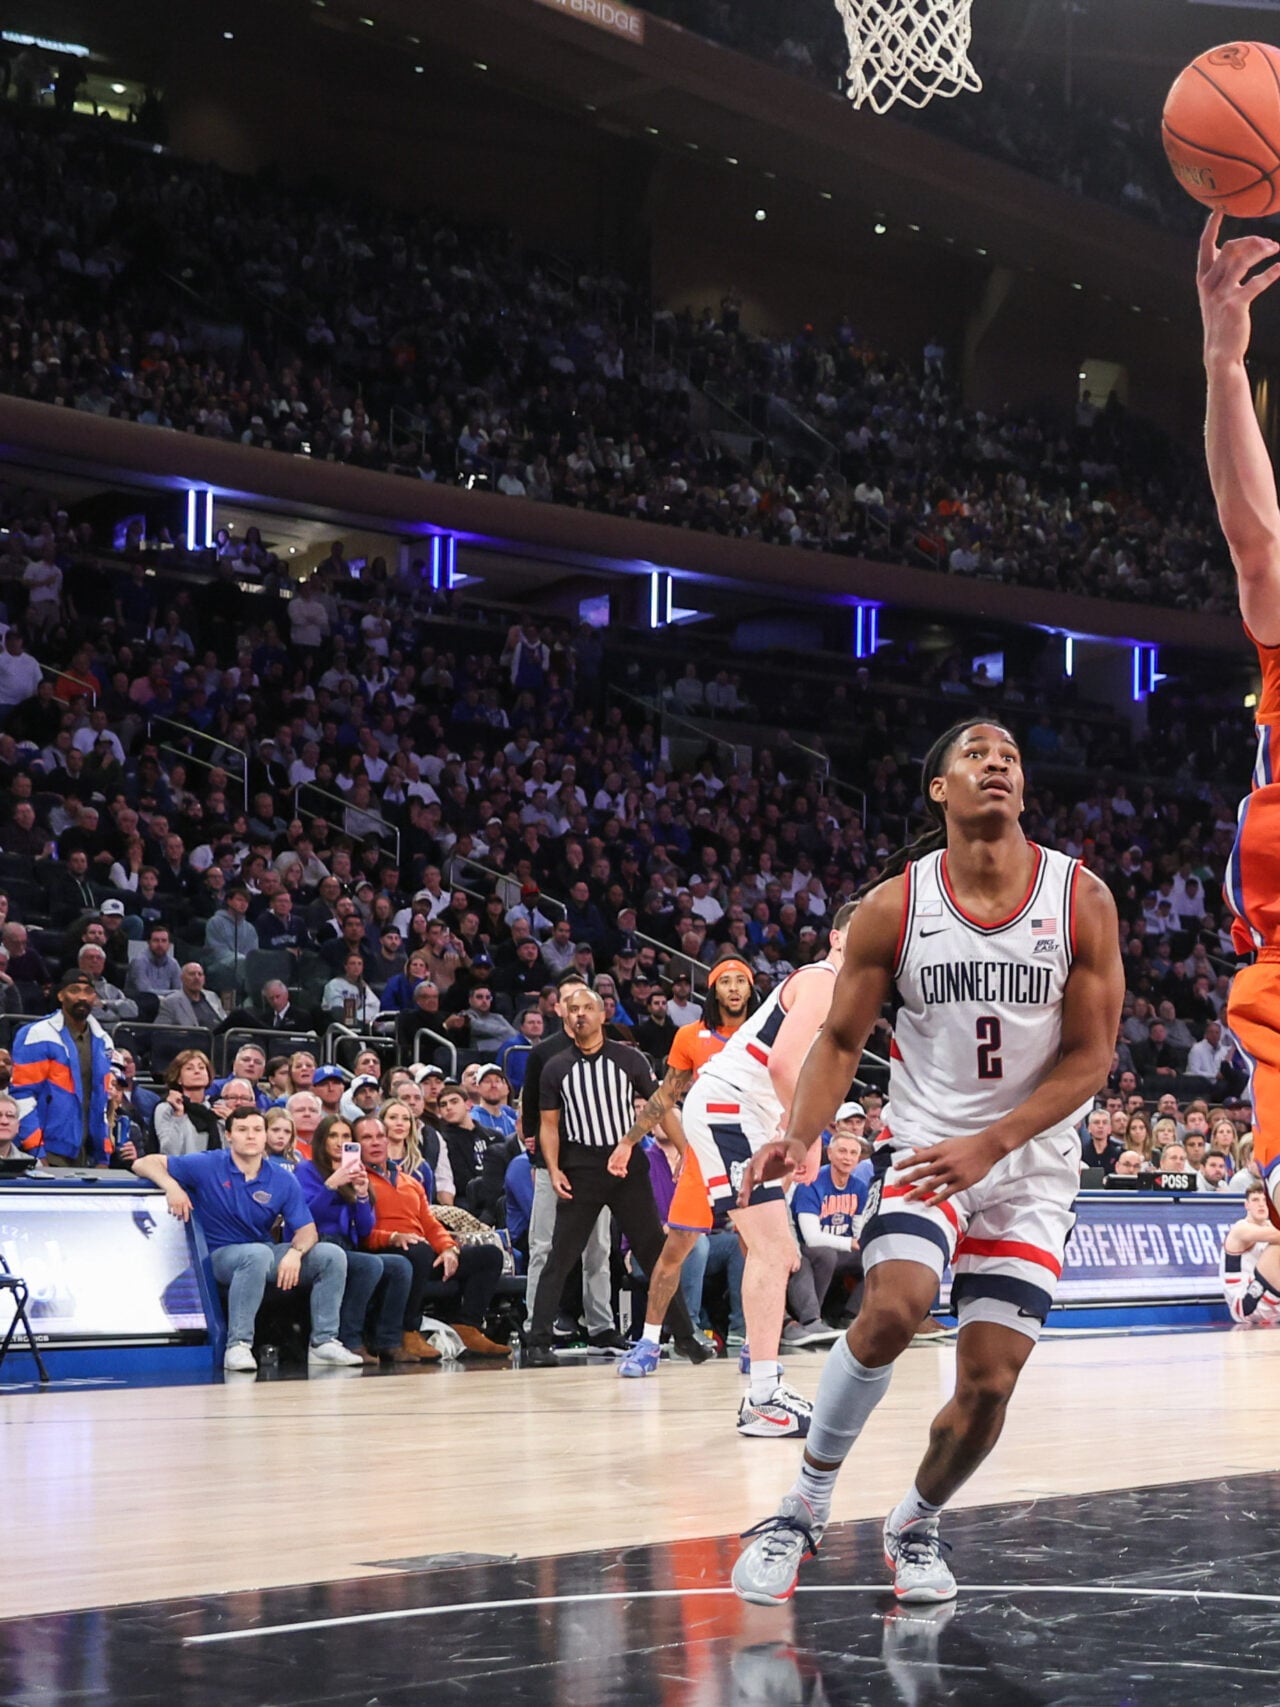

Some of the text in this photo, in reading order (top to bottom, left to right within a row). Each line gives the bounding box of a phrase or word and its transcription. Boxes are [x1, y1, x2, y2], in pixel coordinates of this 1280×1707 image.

[570, 0, 641, 36] BRIDGE
[920, 960, 1053, 1005] CONNECTICUT
[976, 1016, 1003, 1080] 2
[1161, 1174, 1189, 1188] POSS
[1065, 1223, 1169, 1267] BREWED
[1167, 1223, 1221, 1265] FOR
